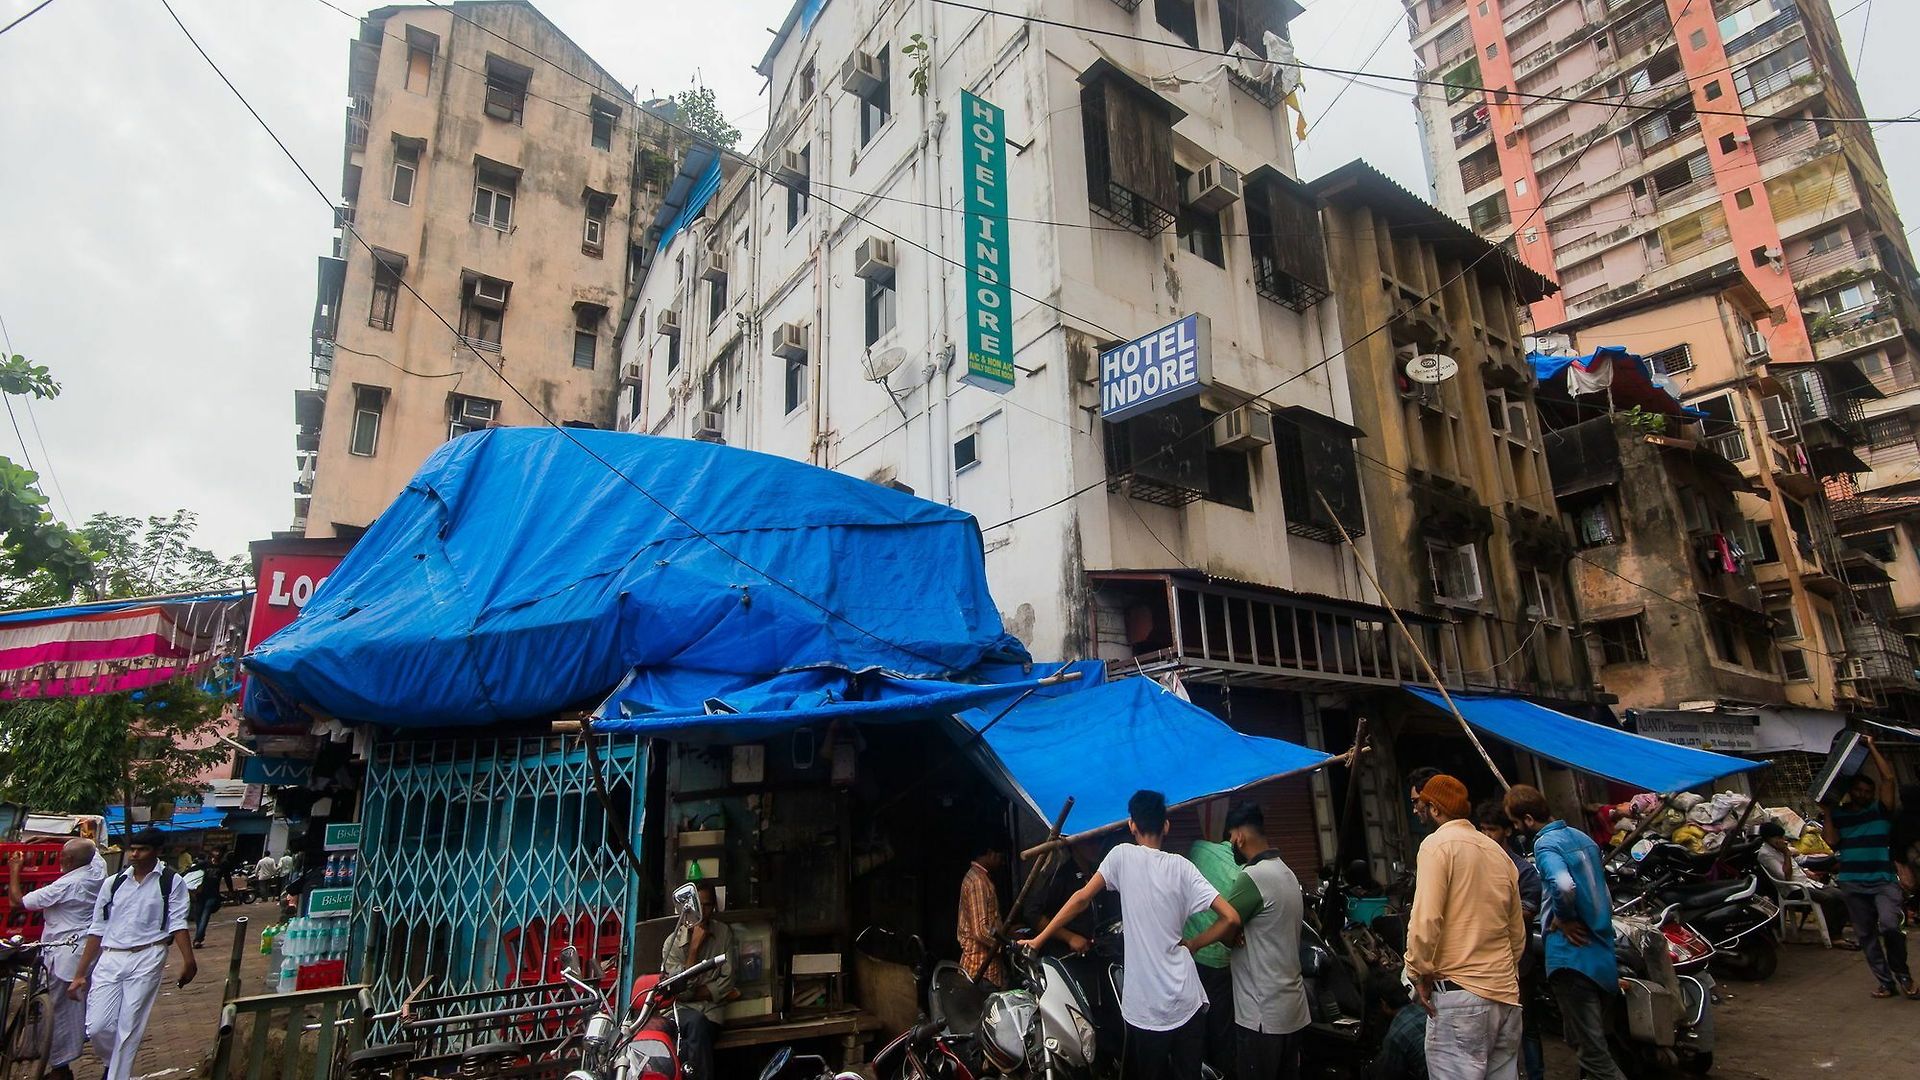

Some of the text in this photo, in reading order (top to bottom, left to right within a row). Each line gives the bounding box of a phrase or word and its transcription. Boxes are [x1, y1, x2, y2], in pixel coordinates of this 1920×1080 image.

[972, 100, 1000, 355] HOTEL INDORE
[1103, 322, 1195, 383] HOTEL
[1103, 351, 1196, 412] INDORE
[268, 571, 328, 608] LO
